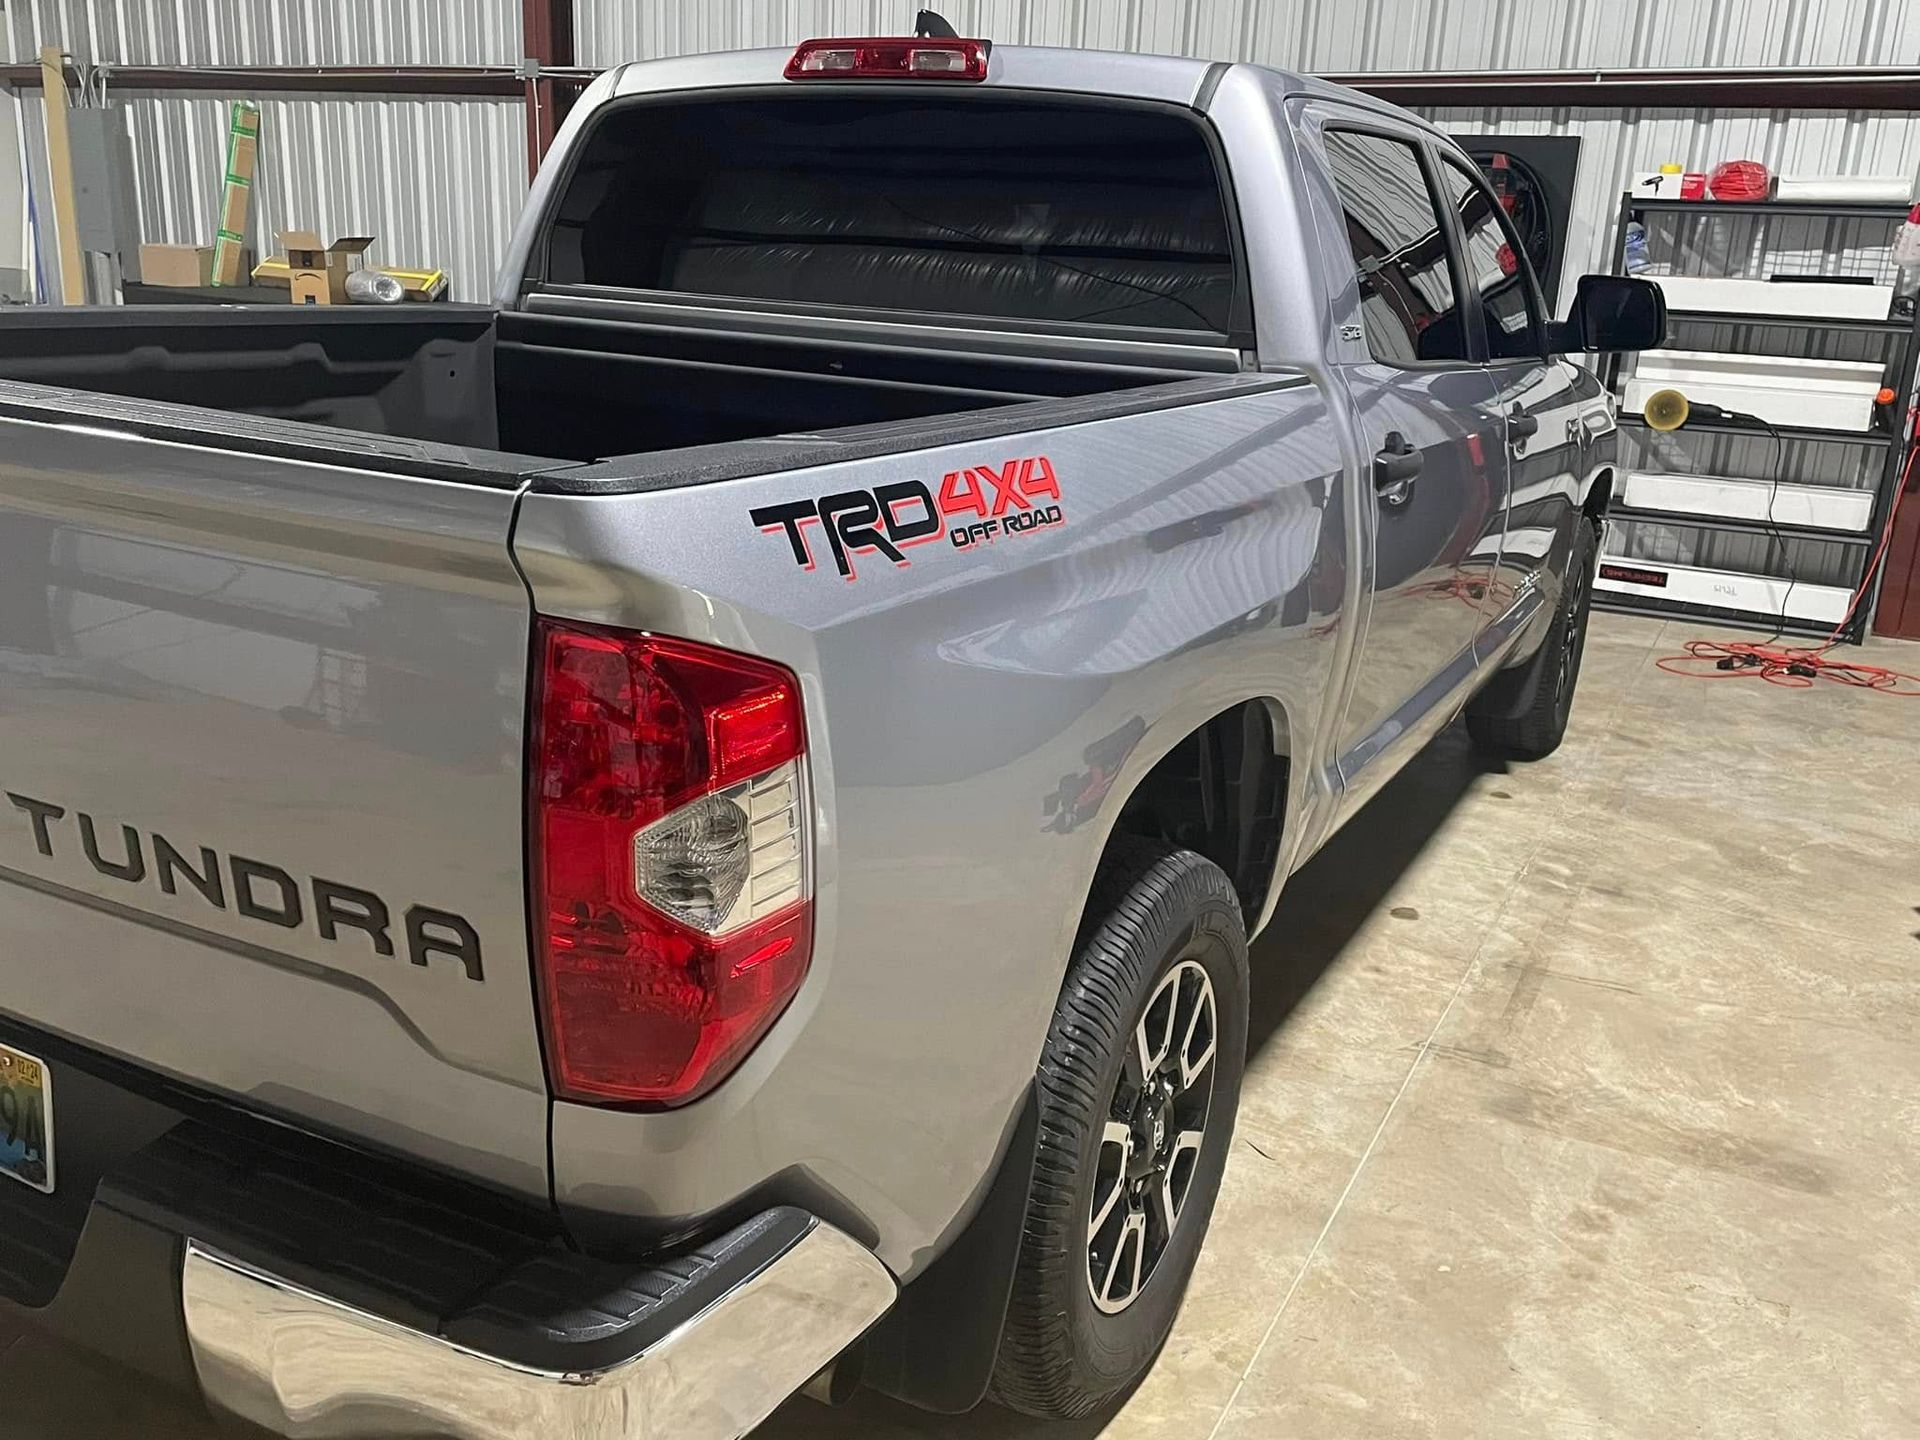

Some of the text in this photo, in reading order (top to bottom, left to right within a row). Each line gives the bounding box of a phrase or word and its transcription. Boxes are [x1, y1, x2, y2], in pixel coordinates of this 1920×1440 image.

[749, 456, 1064, 581] TRD 4X4
[950, 505, 1064, 549] OFF ROAD
[5, 791, 486, 982] TUNDRA
